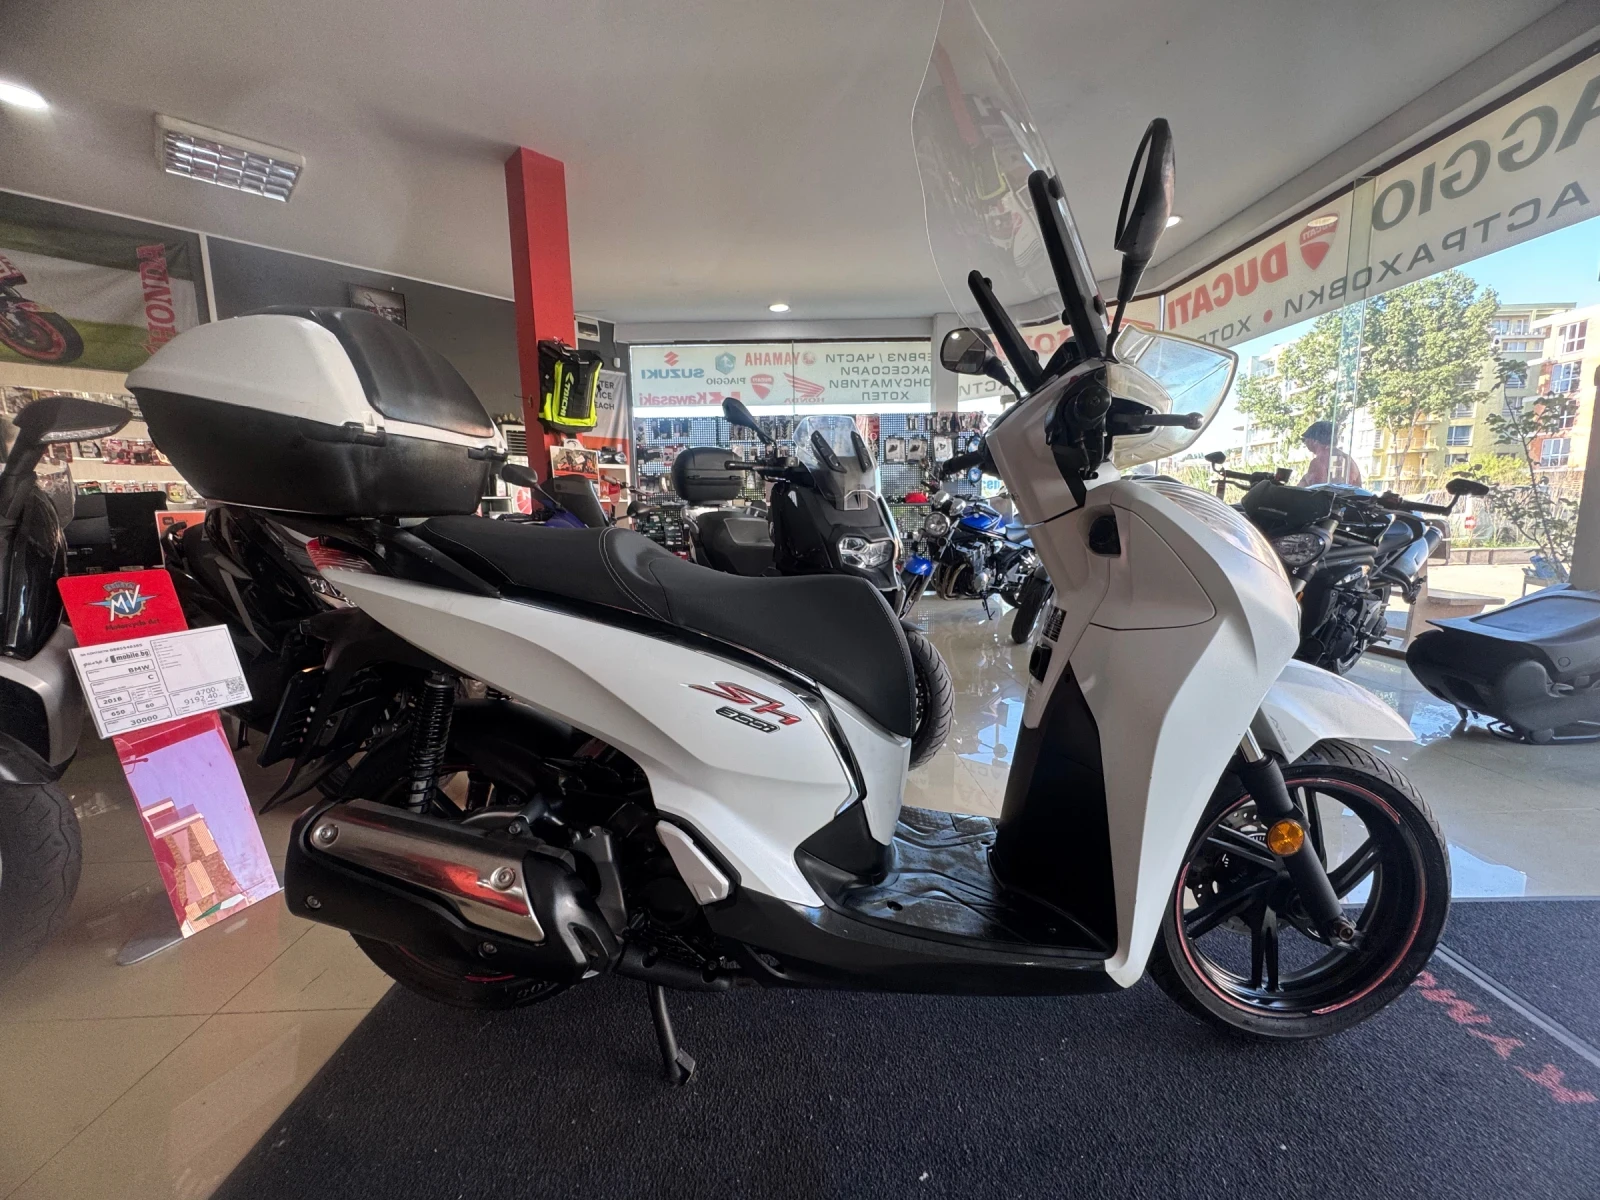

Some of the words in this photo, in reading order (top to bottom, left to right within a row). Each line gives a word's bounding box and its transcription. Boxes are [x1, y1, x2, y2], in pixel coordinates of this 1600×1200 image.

[136, 243, 176, 344] HONDA
[109, 584, 140, 622] MV
[116, 650, 150, 663] mobile.bg
[128, 664, 150, 673] BMW
[196, 686, 216, 696] 4700
[130, 714, 159, 726] 30000
